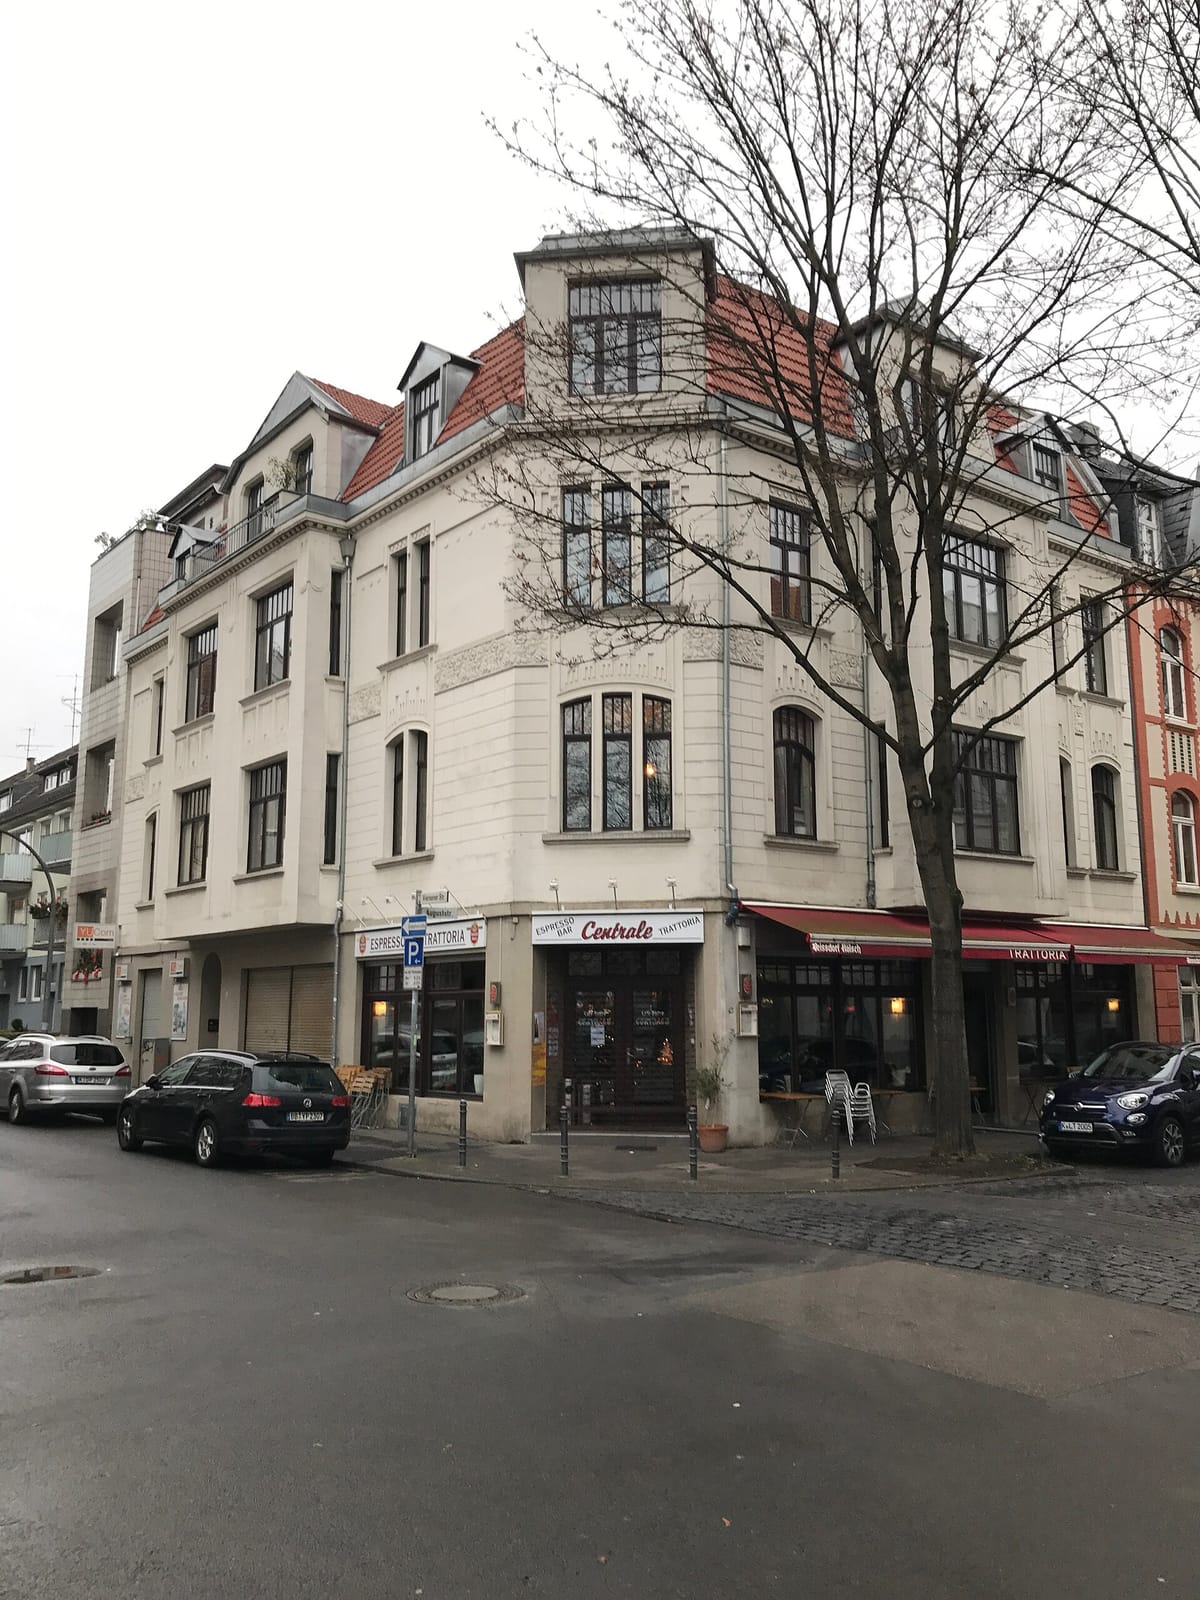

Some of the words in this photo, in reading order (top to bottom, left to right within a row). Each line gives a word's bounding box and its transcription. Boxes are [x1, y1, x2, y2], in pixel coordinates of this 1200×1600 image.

[535, 916, 575, 936] ESPRESSO
[557, 926, 573, 937] BAR
[581, 920, 653, 940] Centrale
[658, 916, 701, 936] TRATTORIA
[408, 941, 419, 966] P
[1009, 949, 1067, 960] TRATTORIA
